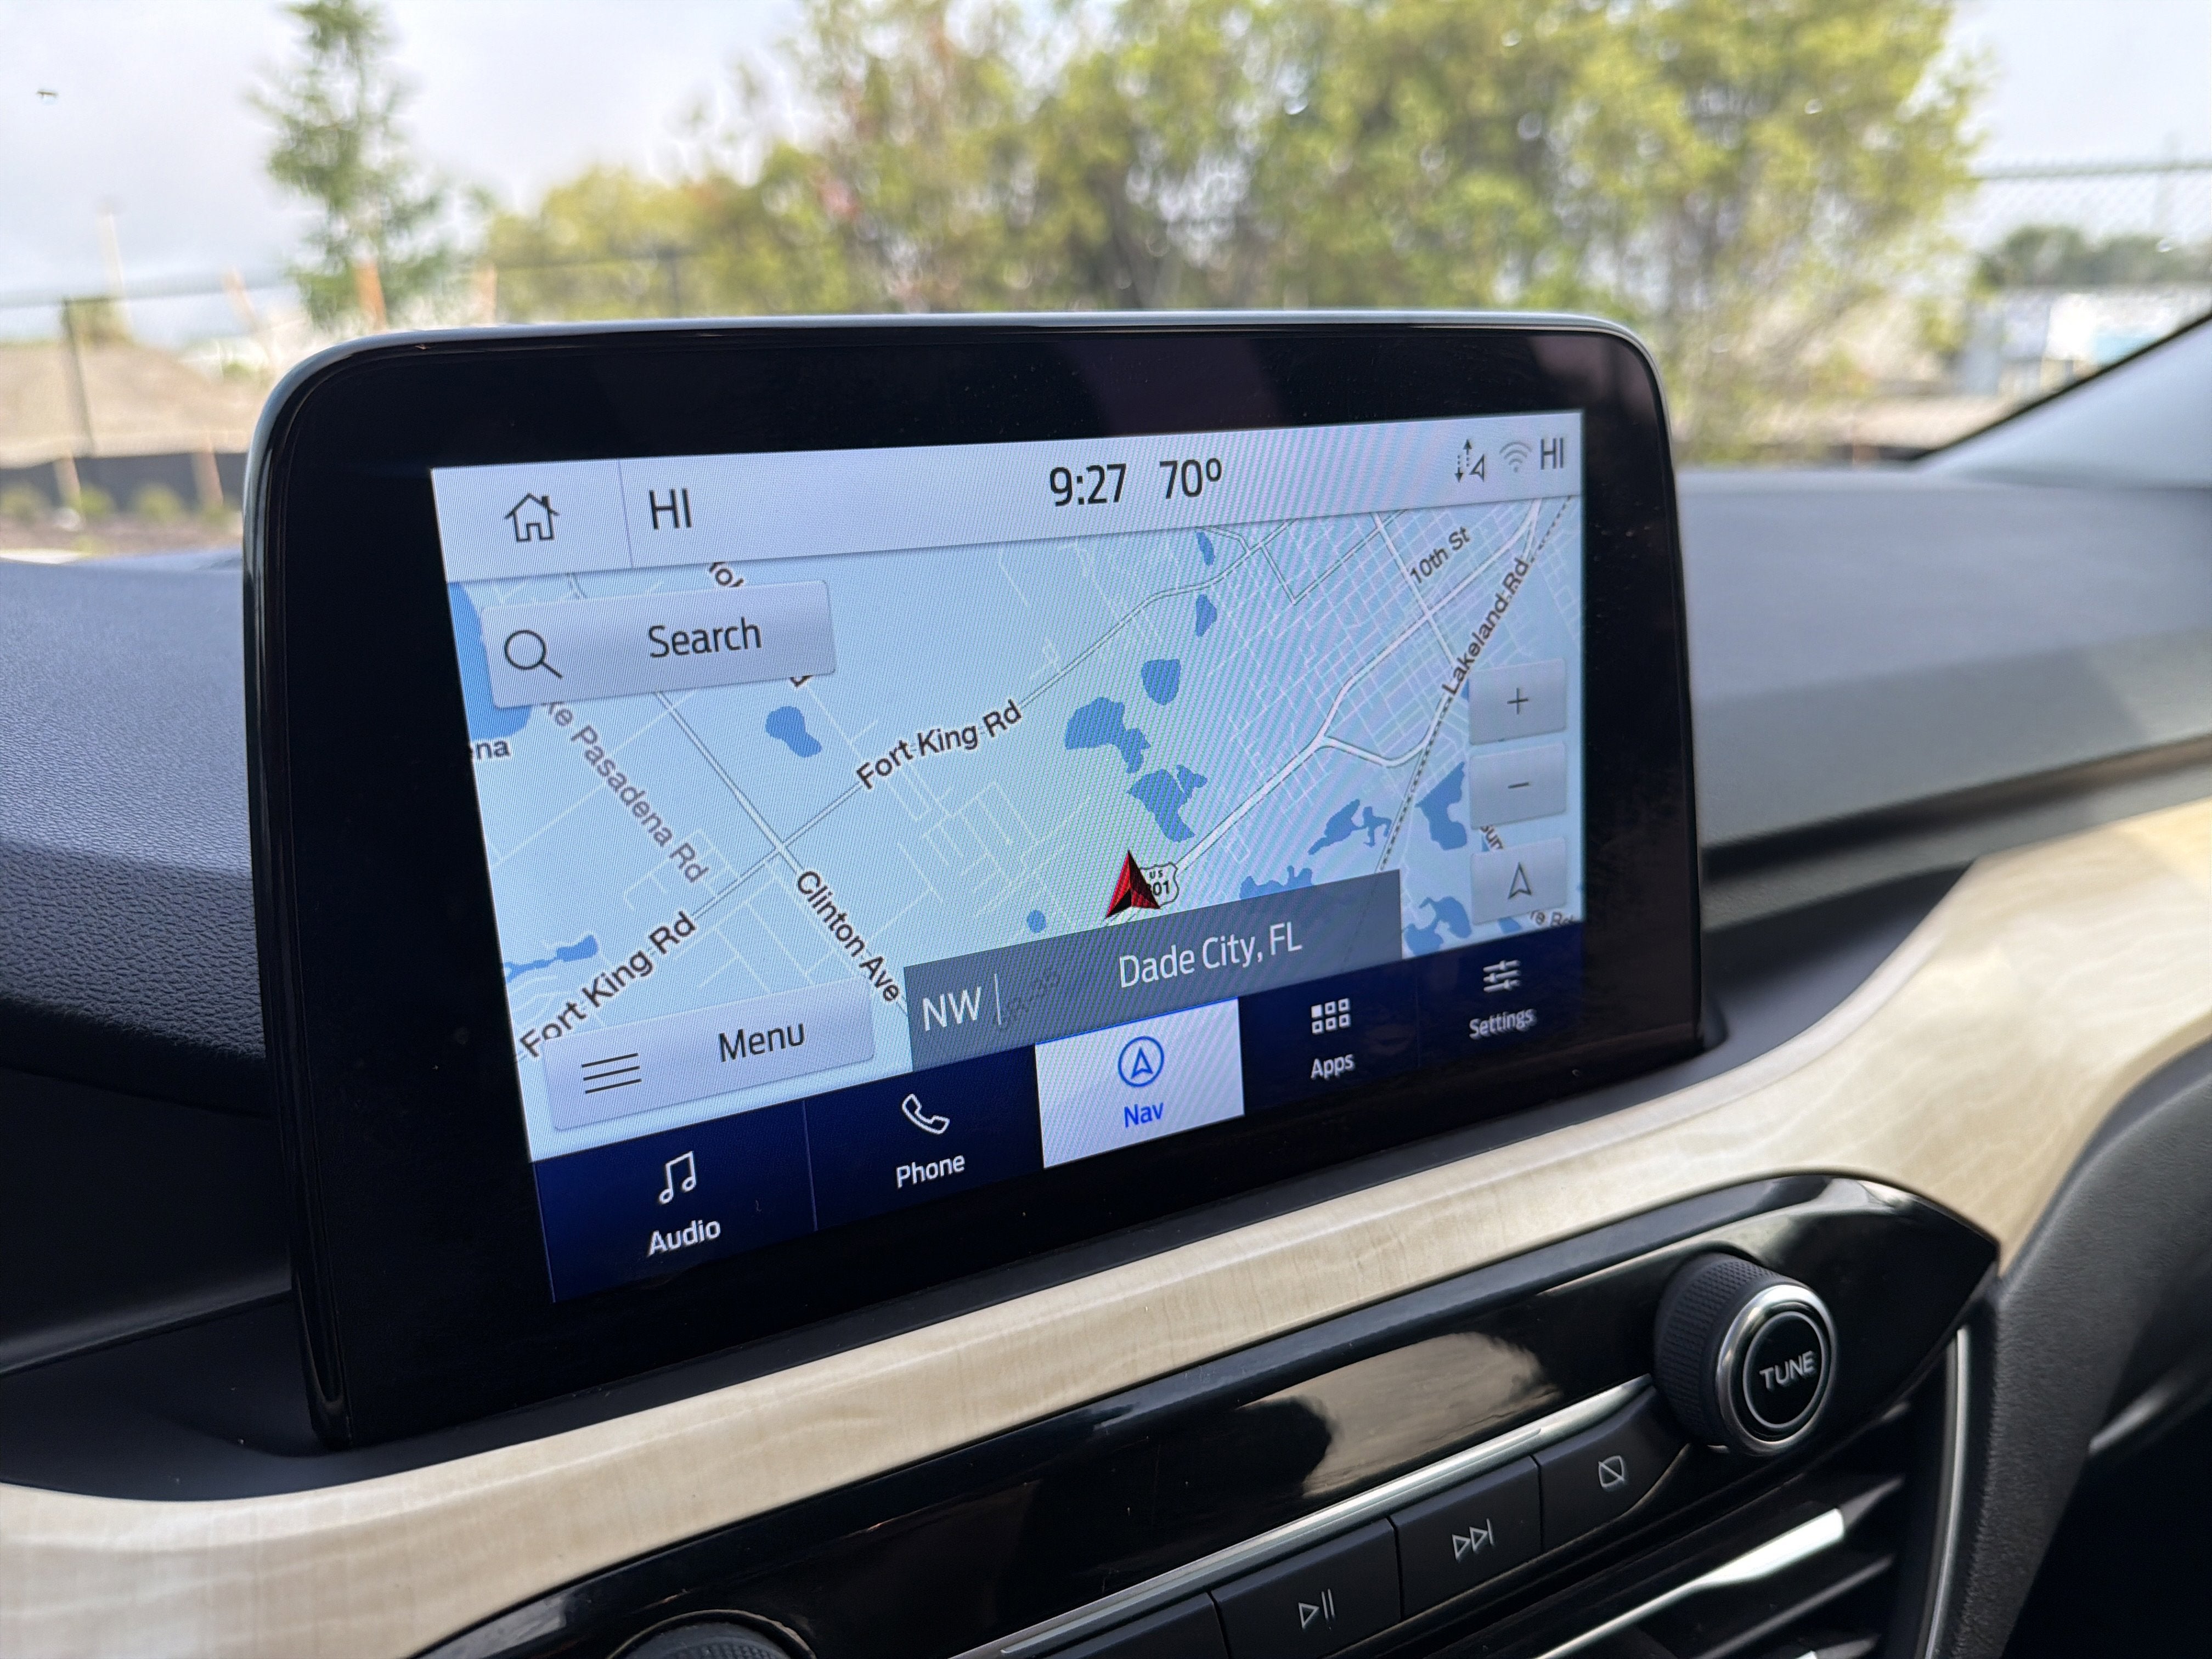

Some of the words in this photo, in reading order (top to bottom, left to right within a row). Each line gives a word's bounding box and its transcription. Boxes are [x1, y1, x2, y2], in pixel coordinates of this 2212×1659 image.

[1540, 437, 1565, 471] HI
[1049, 464, 1127, 507] 9:27
[649, 488, 693, 529] HI
[1409, 548, 1449, 584] 10th
[1448, 526, 1471, 551] St
[648, 617, 763, 658] Search
[1441, 592, 1510, 695] Lakeland
[1502, 557, 1530, 595] Rd
[856, 740, 914, 790] Fort
[917, 728, 979, 757] King
[983, 698, 1022, 738] Rd
[571, 725, 673, 847] Pasadena
[668, 842, 710, 883] Rd
[1147, 880, 1170, 896] 01
[797, 870, 865, 958] Clinton
[858, 956, 900, 1002] Ave
[1119, 944, 1196, 988] Dade
[1202, 934, 1263, 970] City,
[1269, 922, 1303, 956] FL
[520, 1002, 588, 1058] Fort
[582, 950, 654, 1008] King
[648, 910, 697, 955] Rd
[922, 986, 982, 1031] NW
[1469, 1008, 1538, 1040] Settings
[718, 1022, 805, 1063] Menu
[1310, 1052, 1356, 1080] Apps
[1124, 1100, 1165, 1128] Nav
[896, 1154, 967, 1189] Phone
[646, 1217, 721, 1256] Audio
[1759, 1350, 1816, 1392] TUNE
